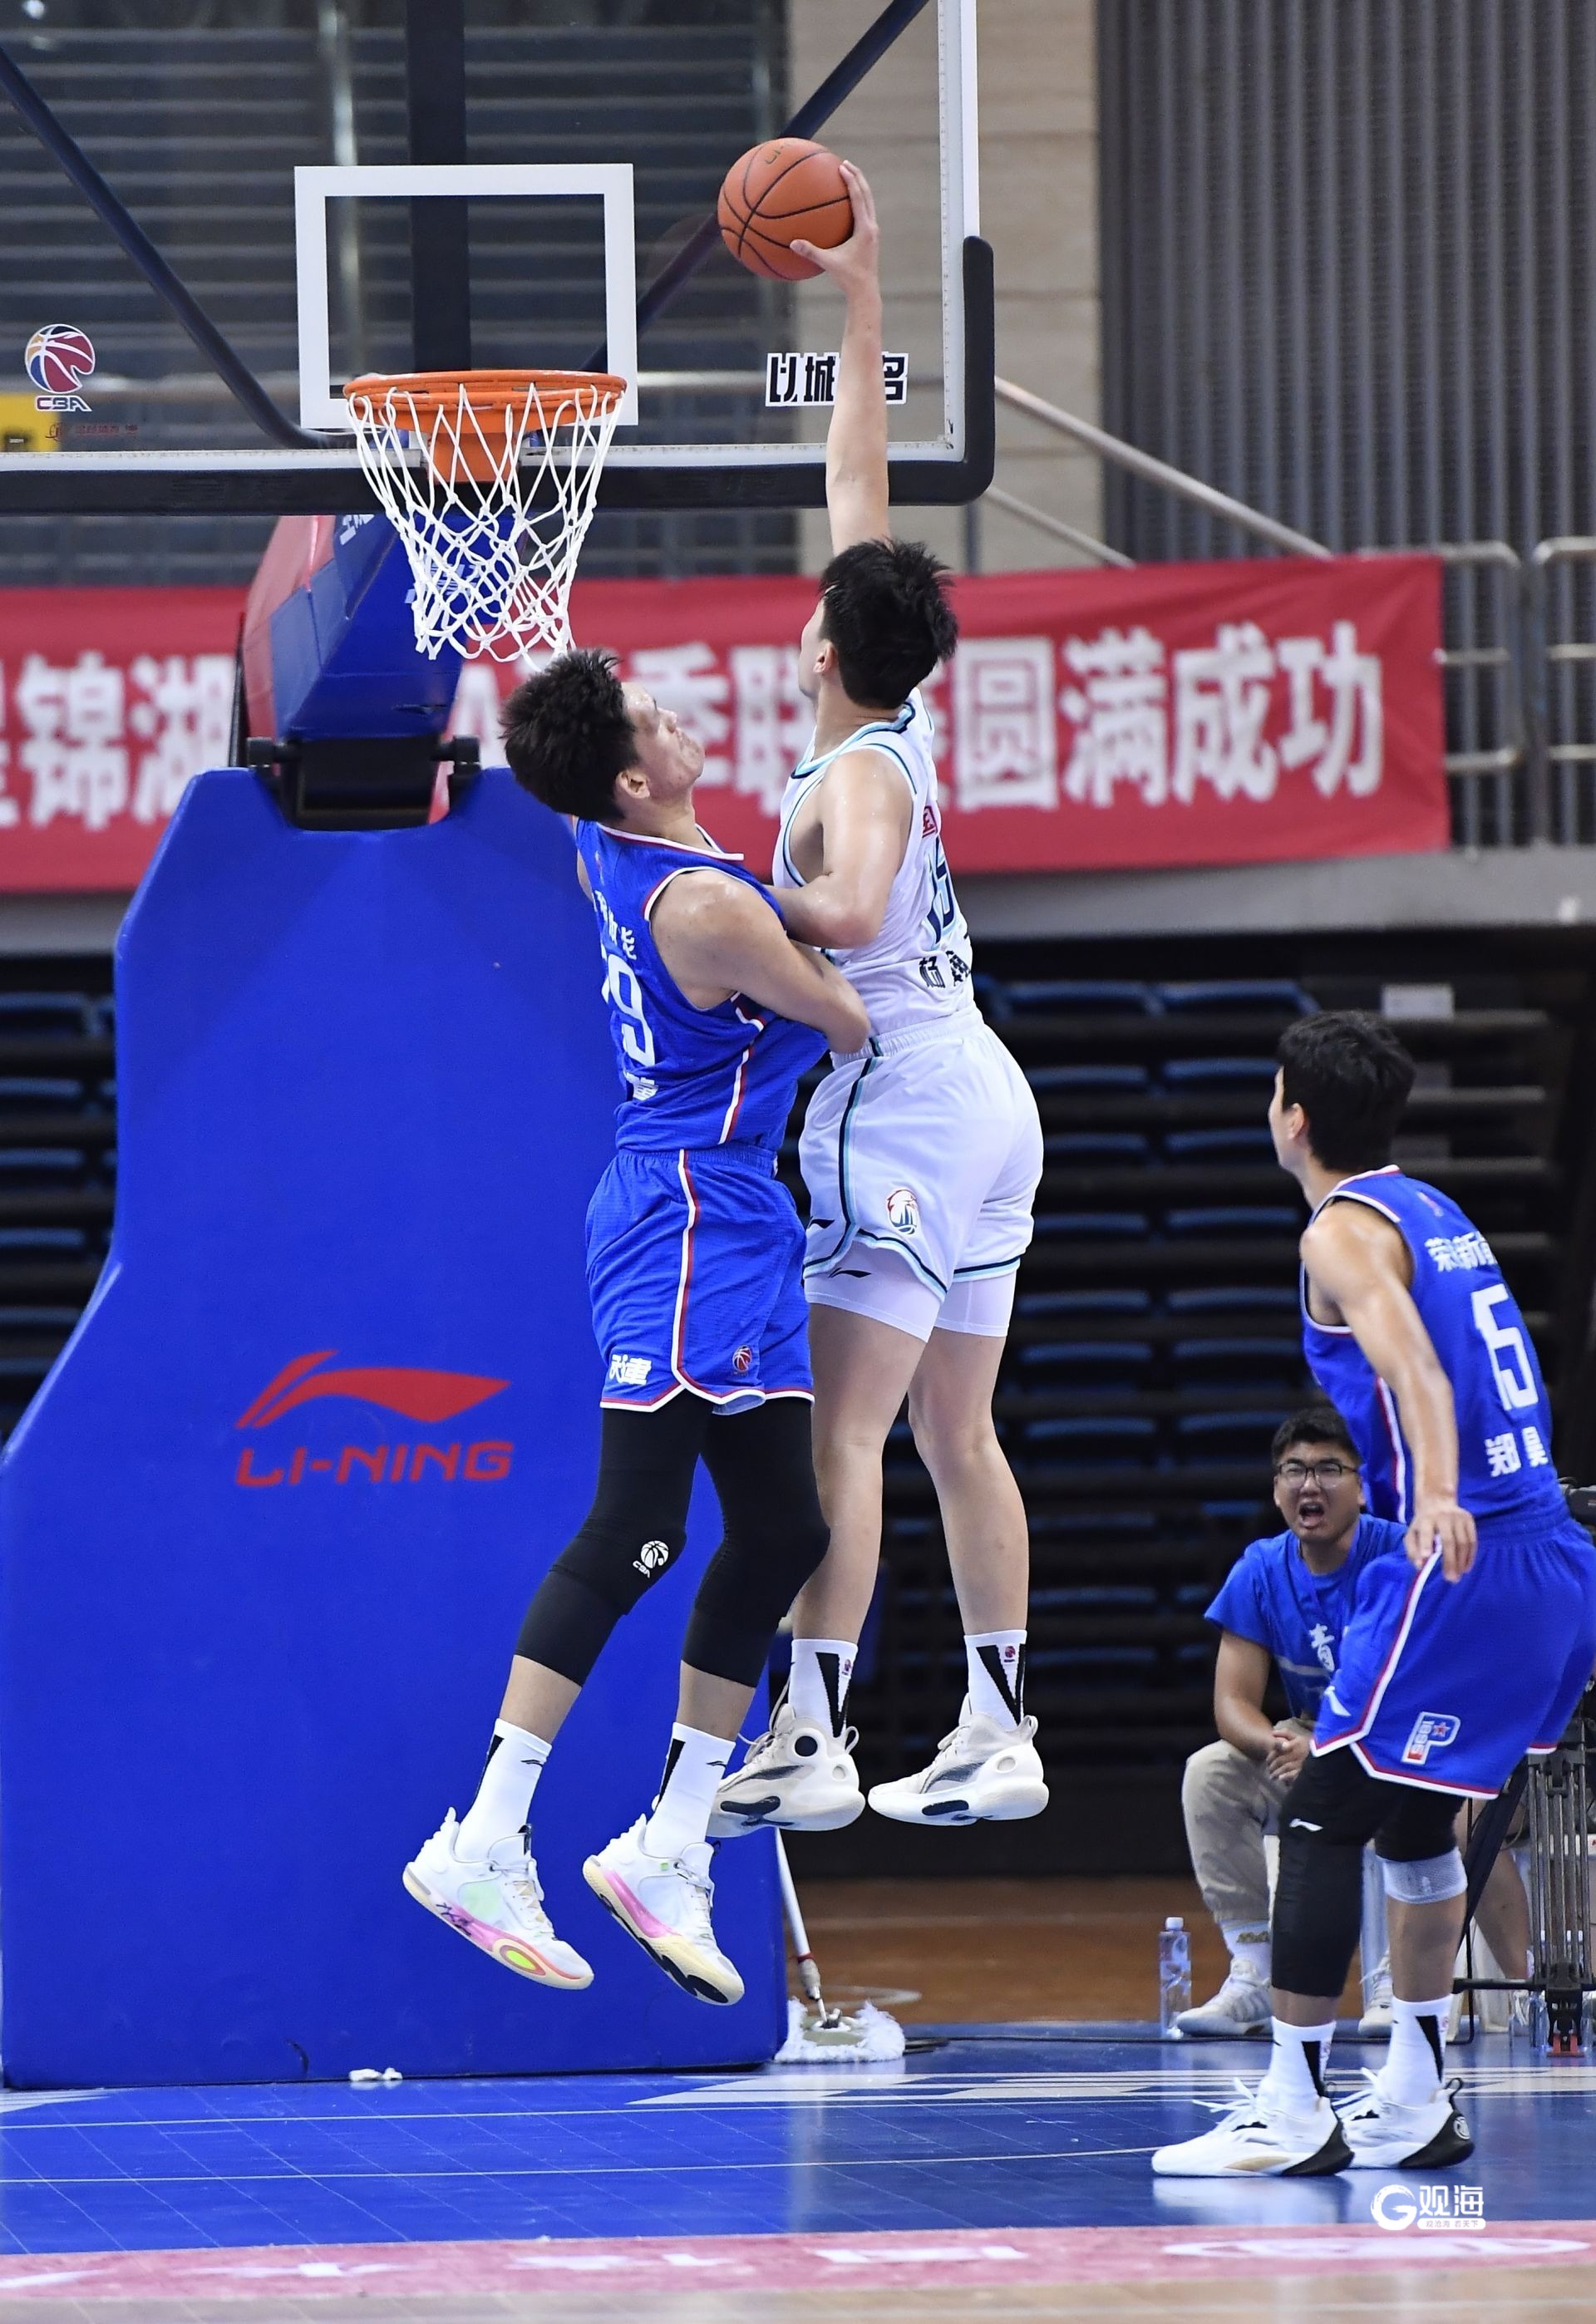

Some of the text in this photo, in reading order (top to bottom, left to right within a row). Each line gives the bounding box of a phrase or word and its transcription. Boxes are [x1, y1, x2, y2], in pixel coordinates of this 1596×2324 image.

[767, 353, 907, 402] 以城名
[36, 395, 92, 412] CBA
[601, 942, 656, 1068] 9
[1470, 1283, 1539, 1411] 6
[235, 1440, 515, 1487] LI-NING
[632, 1559, 651, 1579] CBA
